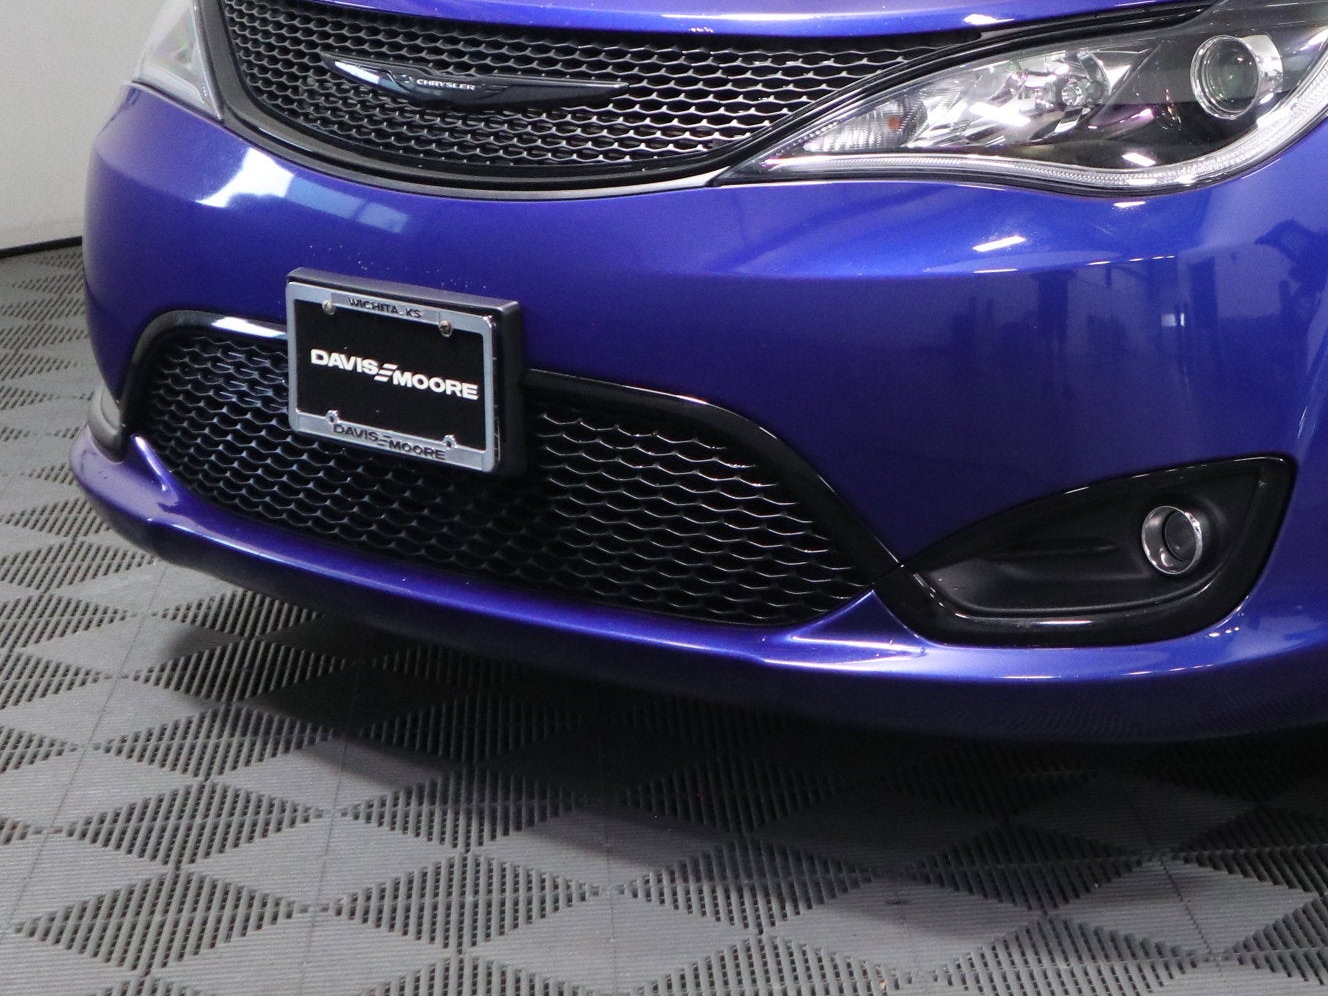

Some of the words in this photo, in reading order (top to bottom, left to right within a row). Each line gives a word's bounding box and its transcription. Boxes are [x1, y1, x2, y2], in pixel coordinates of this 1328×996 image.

[417, 79, 475, 90] CHRYSLER
[405, 307, 422, 319] KS
[310, 348, 379, 375] DAVIS
[393, 370, 479, 401] MOORE
[333, 424, 380, 443] DAVIS
[389, 440, 446, 461] MOORE
